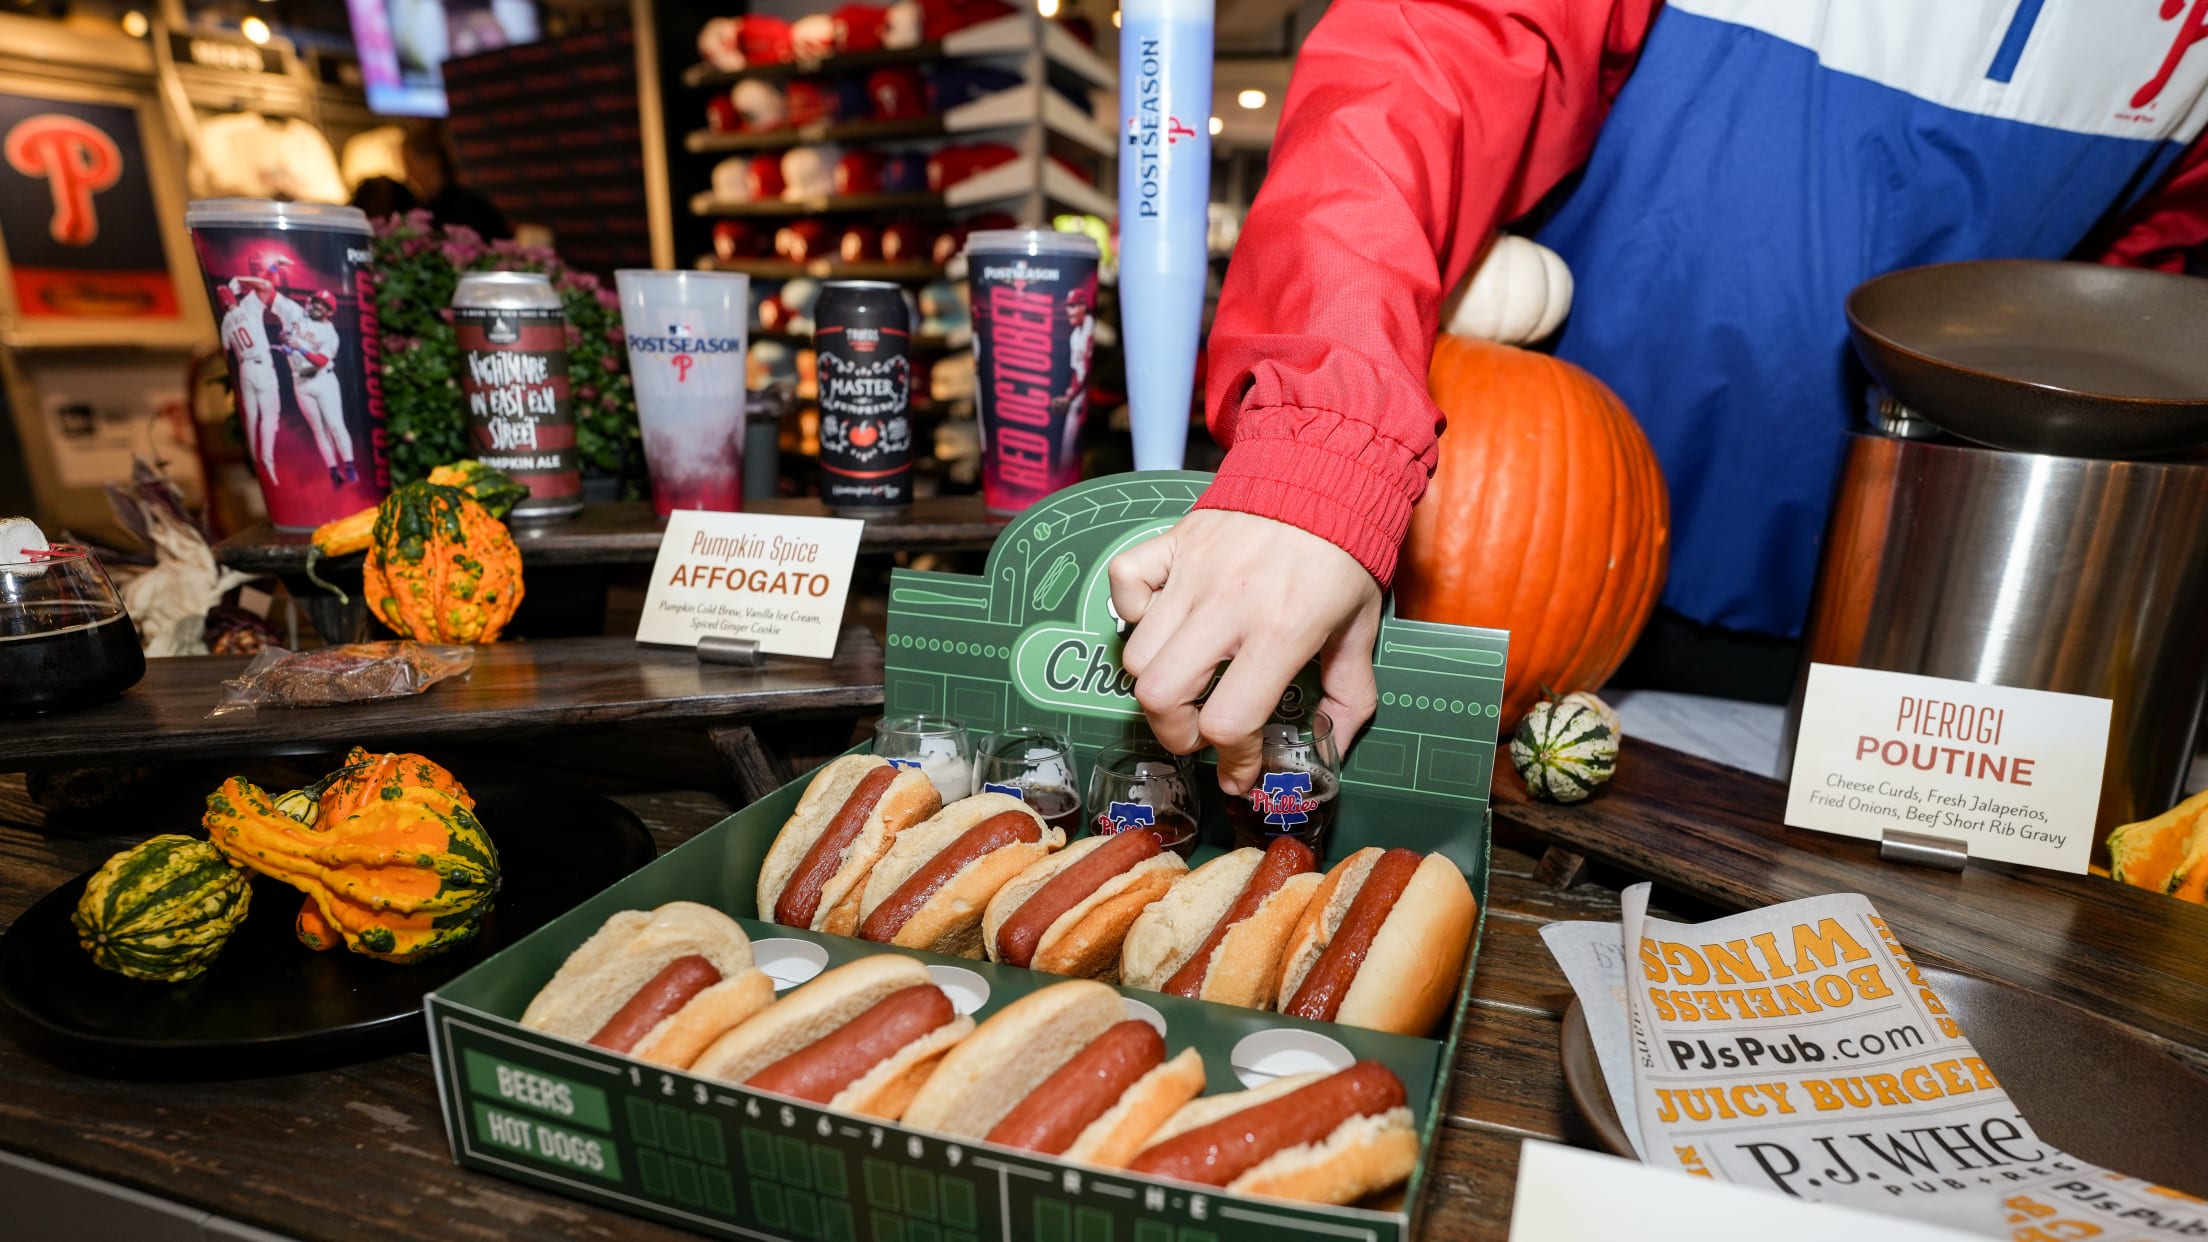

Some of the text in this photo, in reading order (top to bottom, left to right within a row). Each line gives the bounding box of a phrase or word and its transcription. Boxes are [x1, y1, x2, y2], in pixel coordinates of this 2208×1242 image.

[1141, 40, 1160, 217] POSTSEASON
[4, 114, 123, 247] P
[984, 266, 1060, 281] POSTSEASON
[232, 326, 254, 351] 10
[628, 333, 740, 353] POSTSEASON
[468, 350, 548, 389] NIGHTMARE
[829, 377, 899, 402] MASTER
[990, 286, 1054, 491] RED OCTOBER
[490, 382, 524, 419] EAST
[527, 384, 556, 415] ELM
[488, 416, 540, 451] STREET
[536, 454, 561, 470] ALE
[691, 530, 820, 567] Pumpkin Spice
[669, 564, 830, 598] AFFOGATO
[659, 600, 822, 625] Pumpkin Cold Brew, Vanilla Ice Cream,
[690, 617, 781, 636] Spiced Ginger Cookie
[1897, 696, 2005, 746] PIEROGI
[1855, 735, 2037, 787] POUTINE
[1250, 788, 1319, 815] Phillies
[1809, 790, 2068, 849] Fried Onions, Beef Short Rib Gravy
[1826, 773, 2050, 823] Cheese Curds, Fresh Jalapeños,
[1639, 917, 1871, 987] WINGS
[1649, 963, 1894, 1022] BONELESS
[1668, 1024, 1925, 1072] PJsPub.com
[497, 1065, 574, 1116] BEERS
[1657, 1056, 2003, 1124] JUICY BURGER
[488, 1112, 605, 1171] HOT DOGS
[629, 1066, 1208, 1220] 1 2 3 4 5 6 7 8 9 R H E
[1735, 1113, 2045, 1201] P.J.WHe
[1884, 1178, 1967, 1197] PUB
